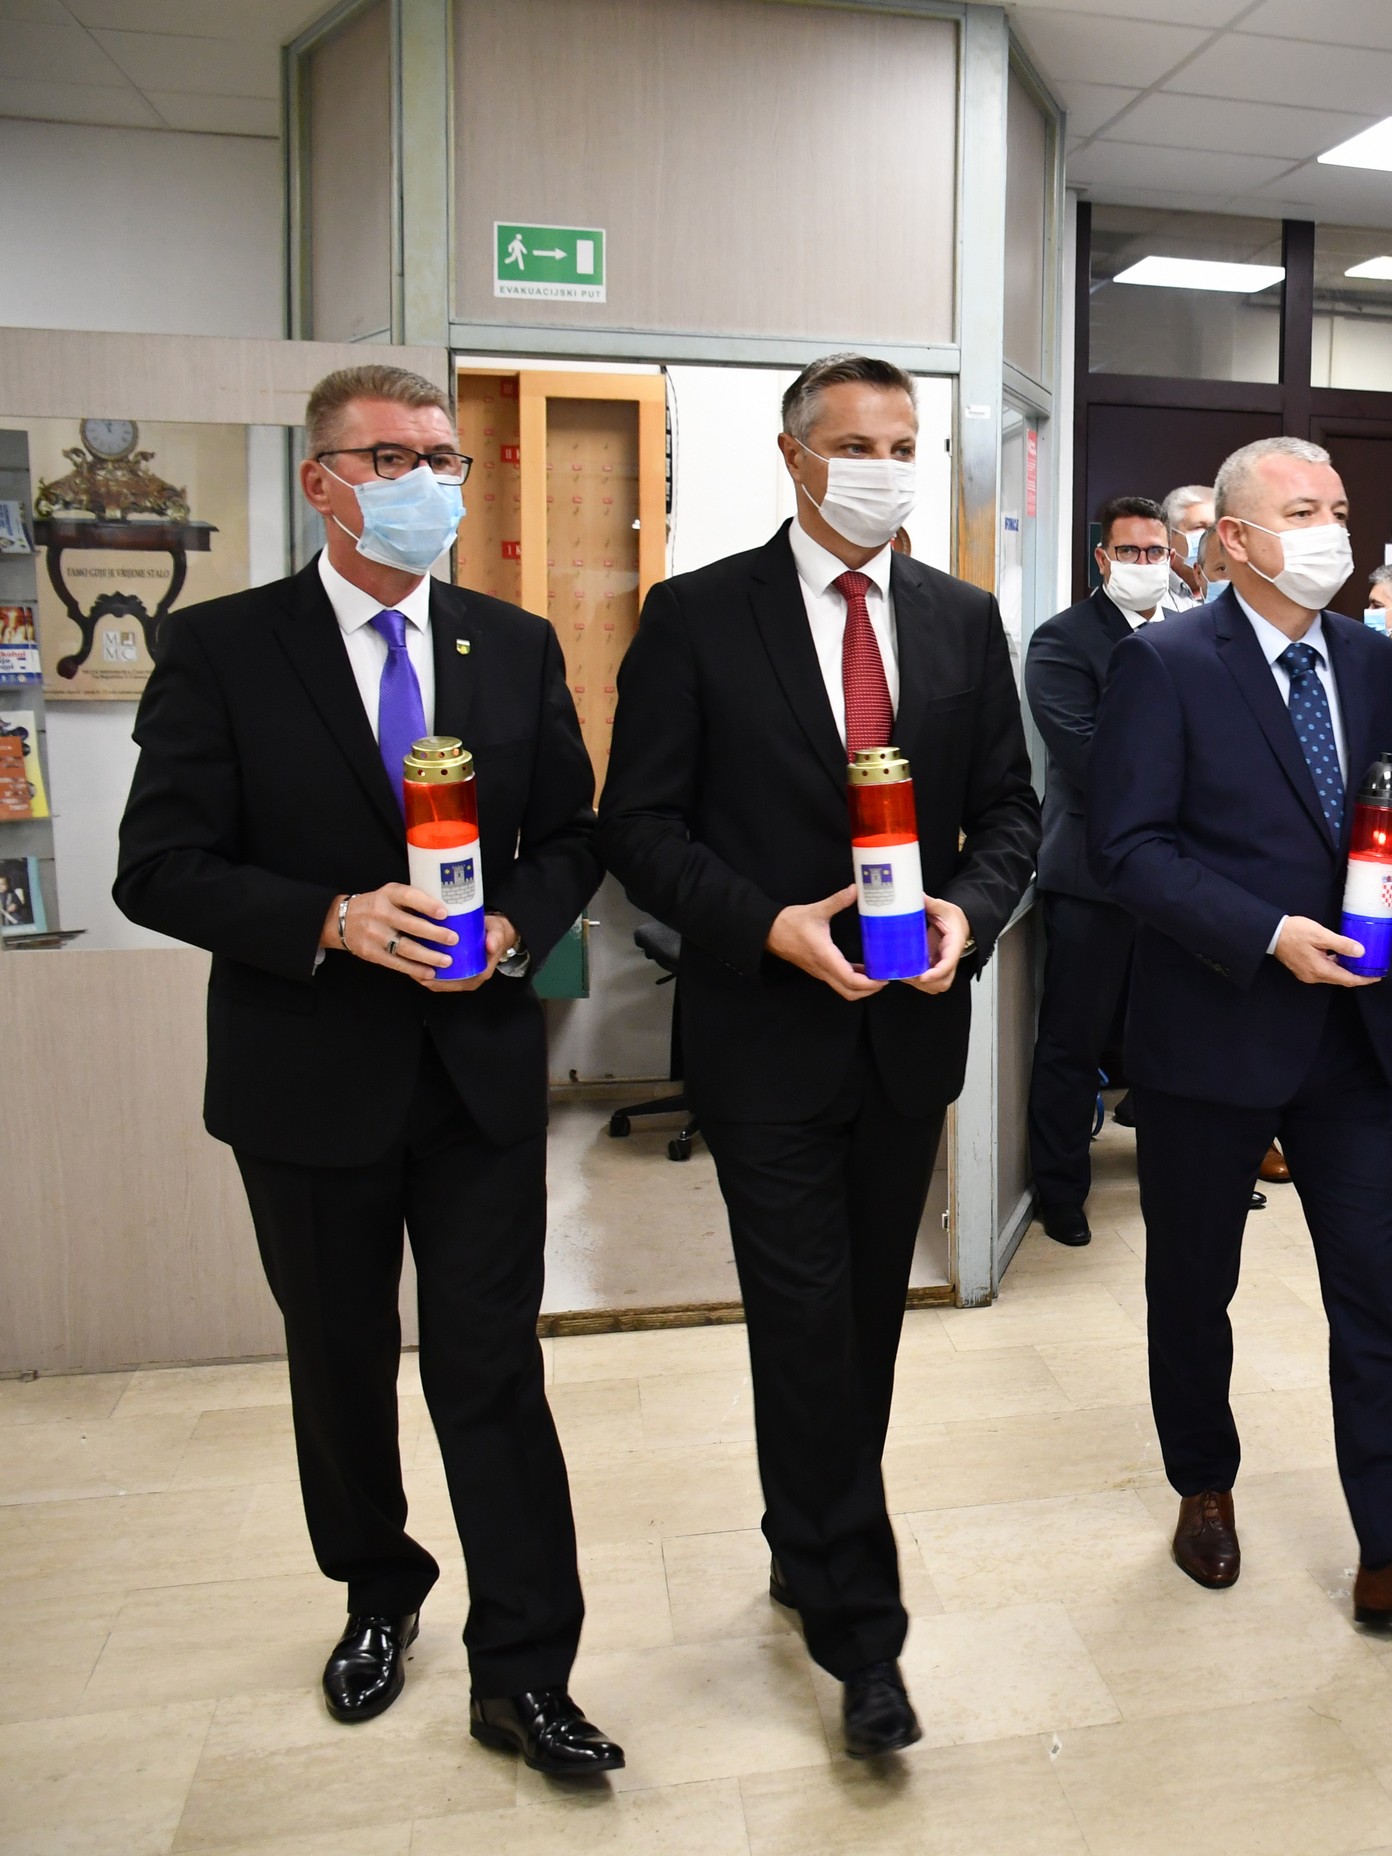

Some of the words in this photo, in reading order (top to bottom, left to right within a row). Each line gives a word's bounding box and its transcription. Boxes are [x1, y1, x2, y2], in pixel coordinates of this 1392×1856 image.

[499, 286, 577, 297] EVAKUACIJSKI
[581, 290, 601, 298] PUT
[147, 569, 170, 578] STALO
